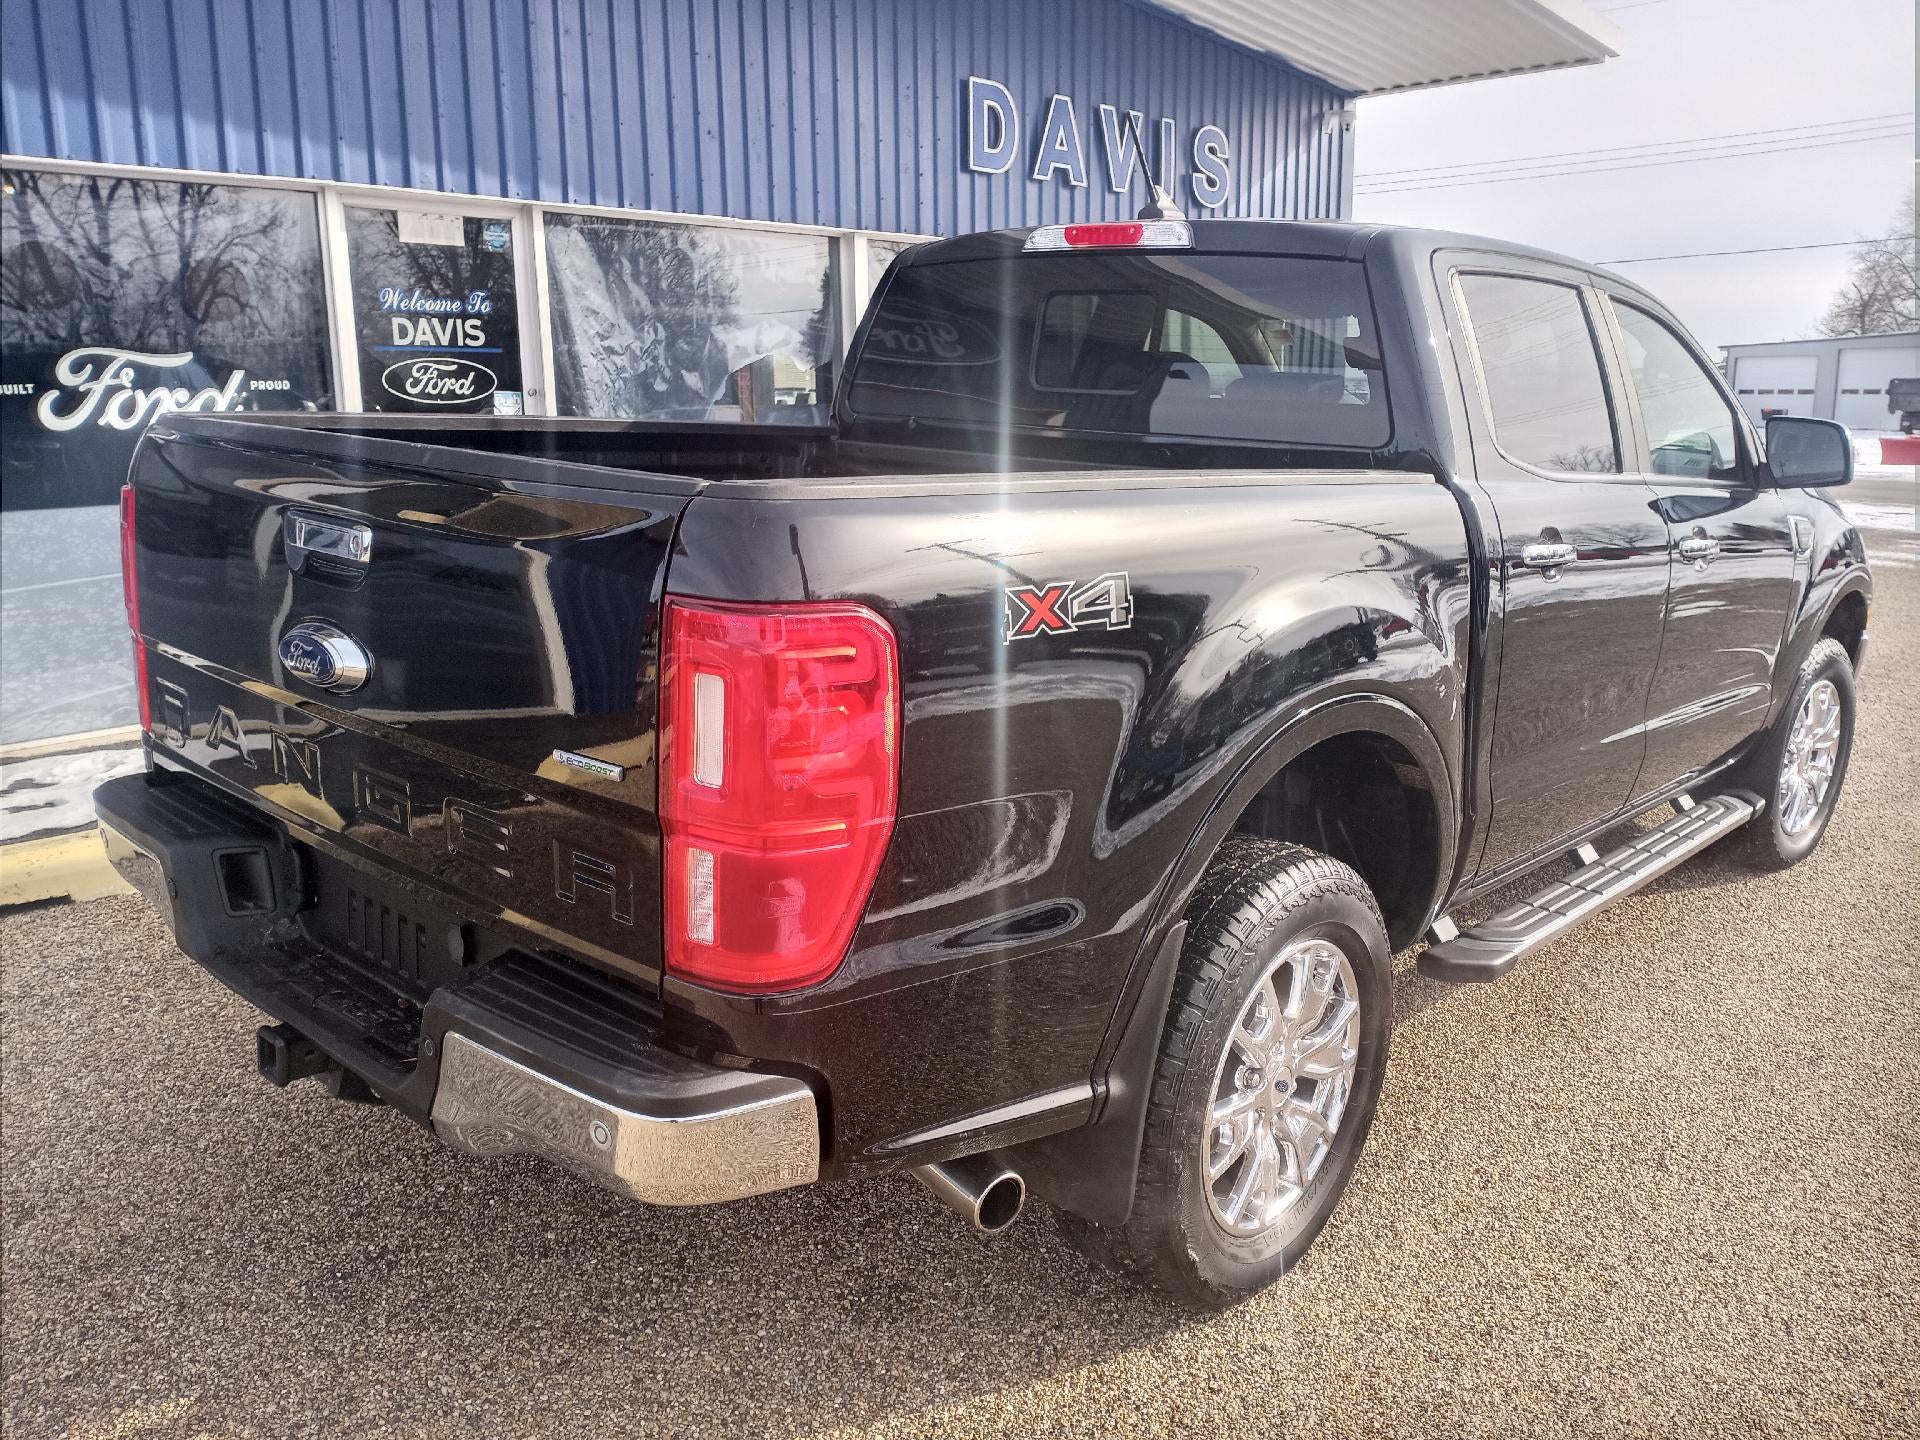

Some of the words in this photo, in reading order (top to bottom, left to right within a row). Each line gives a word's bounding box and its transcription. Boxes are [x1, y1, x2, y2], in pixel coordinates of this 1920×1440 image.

[969, 75, 1229, 208] DAVIS
[380, 287, 462, 311] Welcome
[467, 291, 492, 313] To
[391, 317, 486, 347] DAVIS
[250, 380, 290, 391] PROUD
[405, 362, 475, 395] Ford
[288, 640, 320, 675] Ford
[156, 676, 635, 926] RANGER
